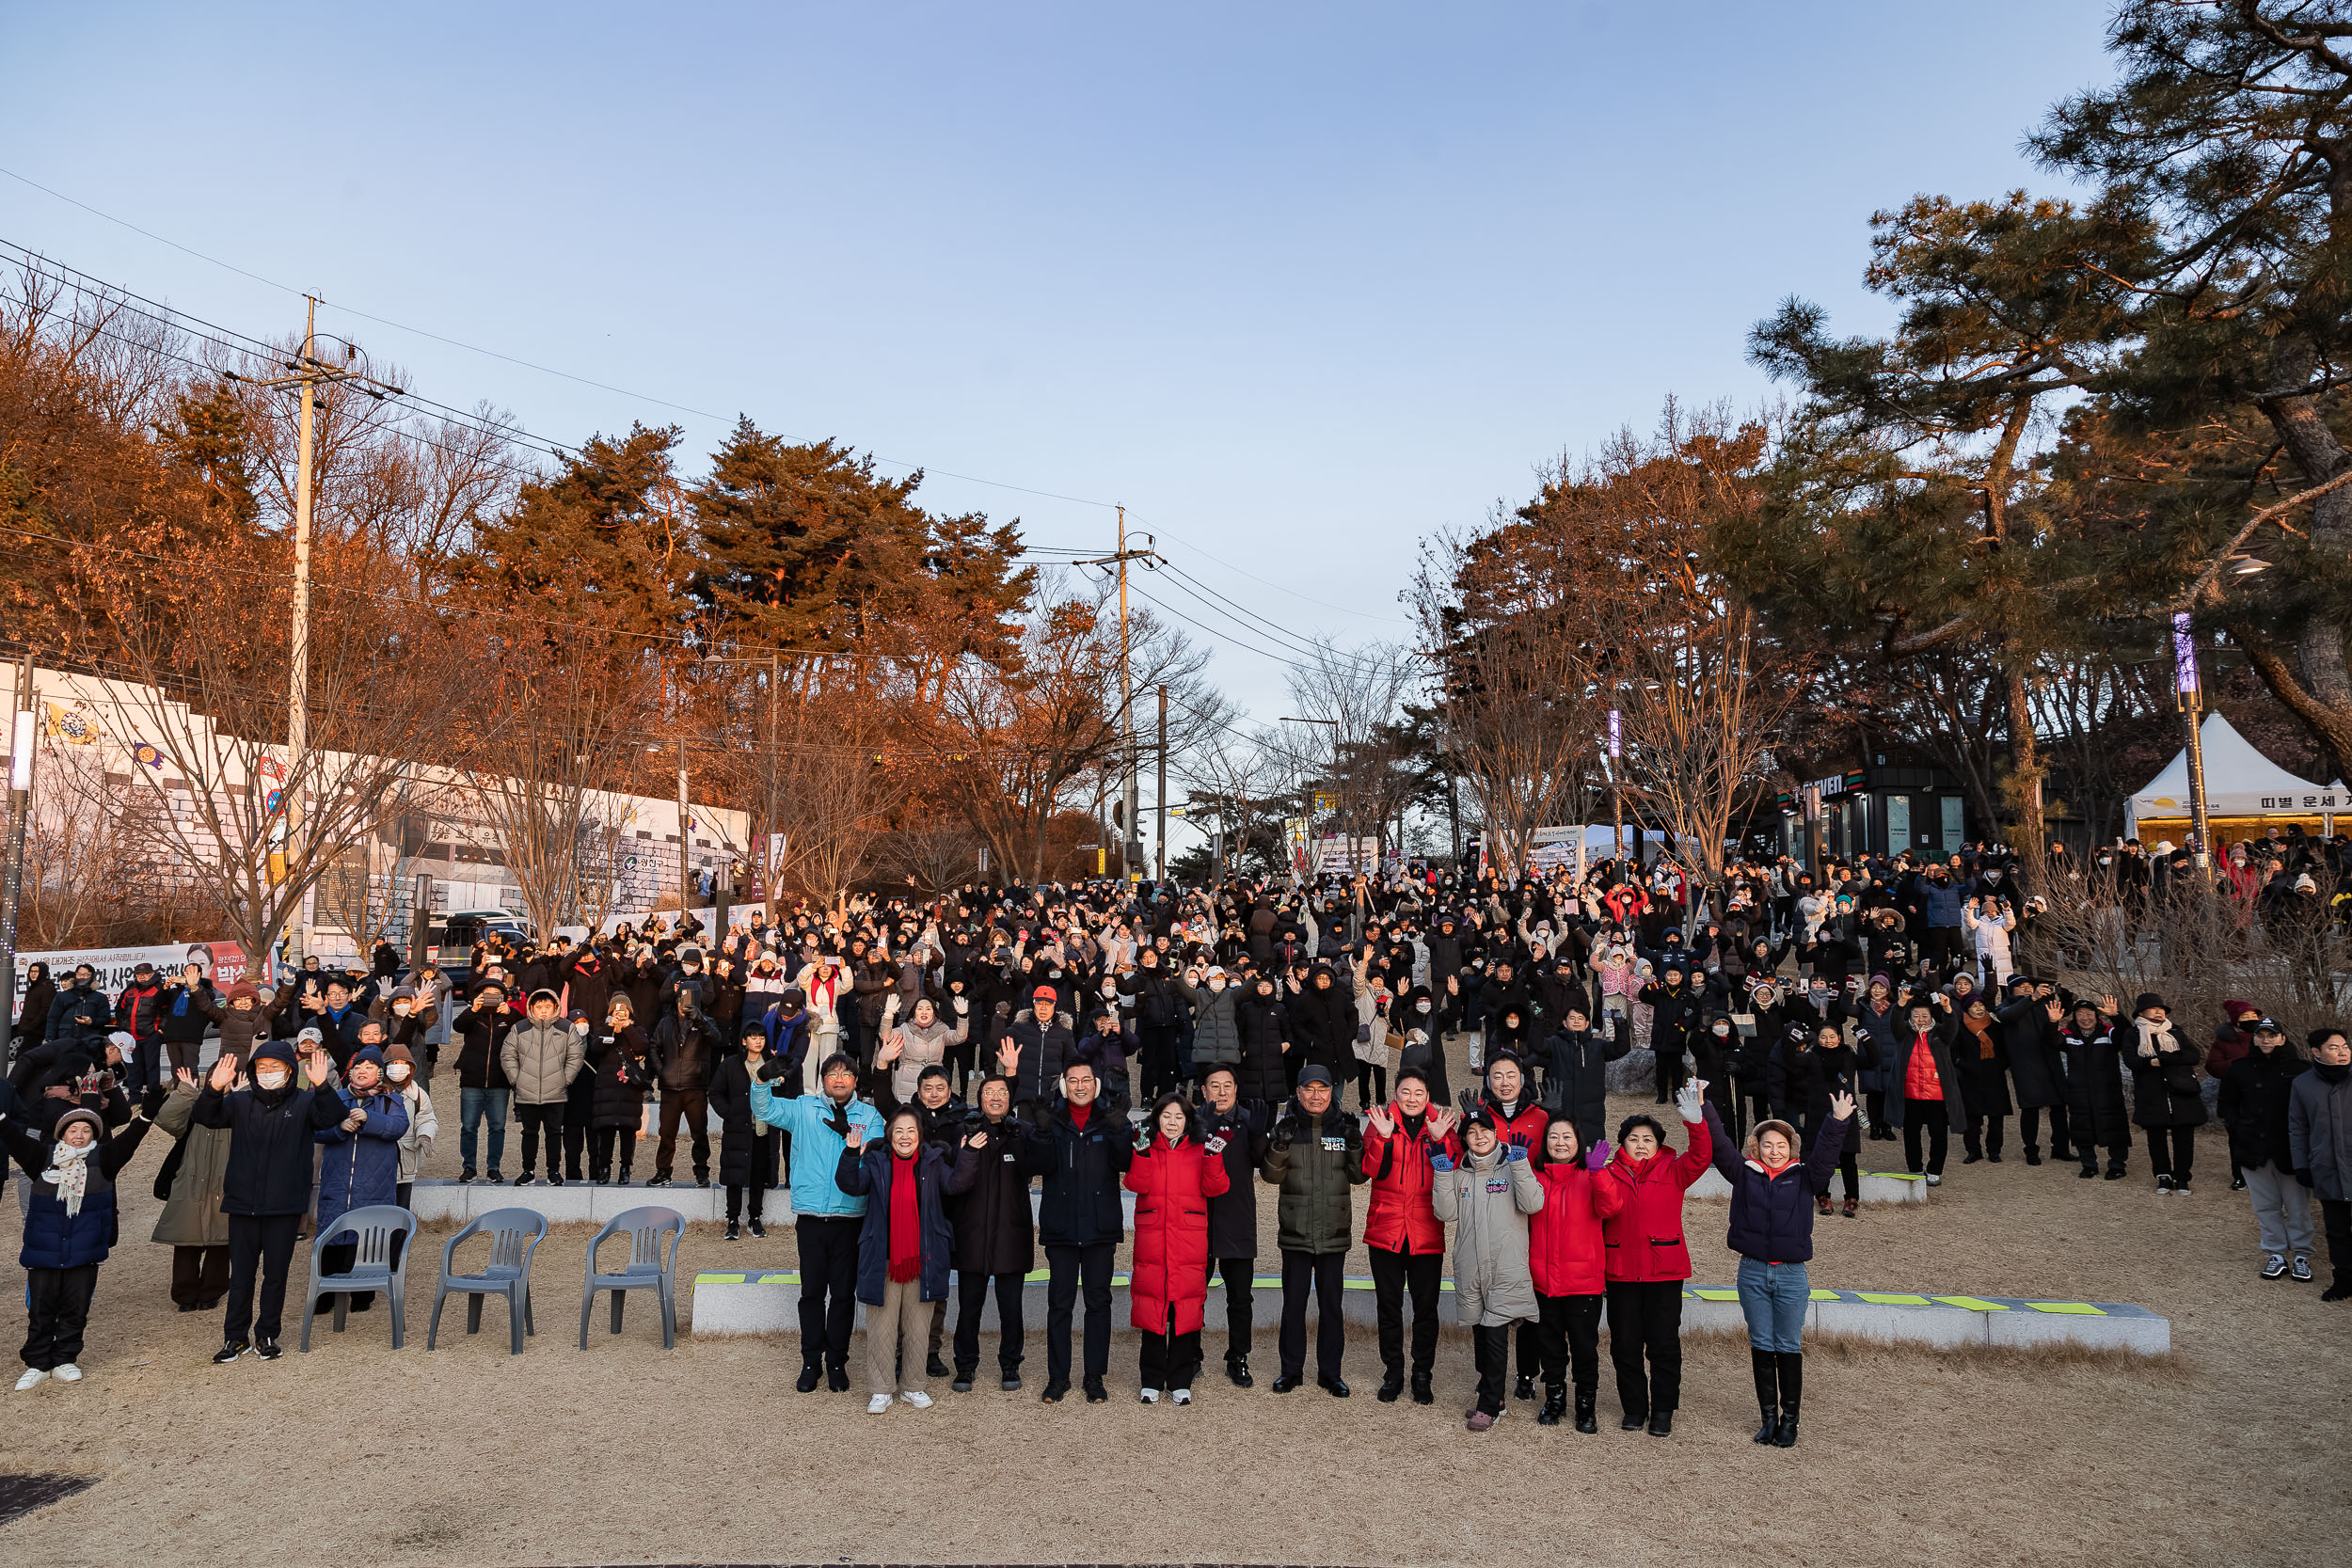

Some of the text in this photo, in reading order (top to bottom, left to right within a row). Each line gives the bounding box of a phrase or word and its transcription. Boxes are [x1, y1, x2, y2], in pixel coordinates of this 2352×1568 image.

[2261, 797, 2293, 809] 띠별
[2302, 796, 2336, 808] 운세
[52, 956, 75, 966] 대개조
[76, 954, 107, 965] 광진에서
[1470, 1111, 1479, 1119] N
